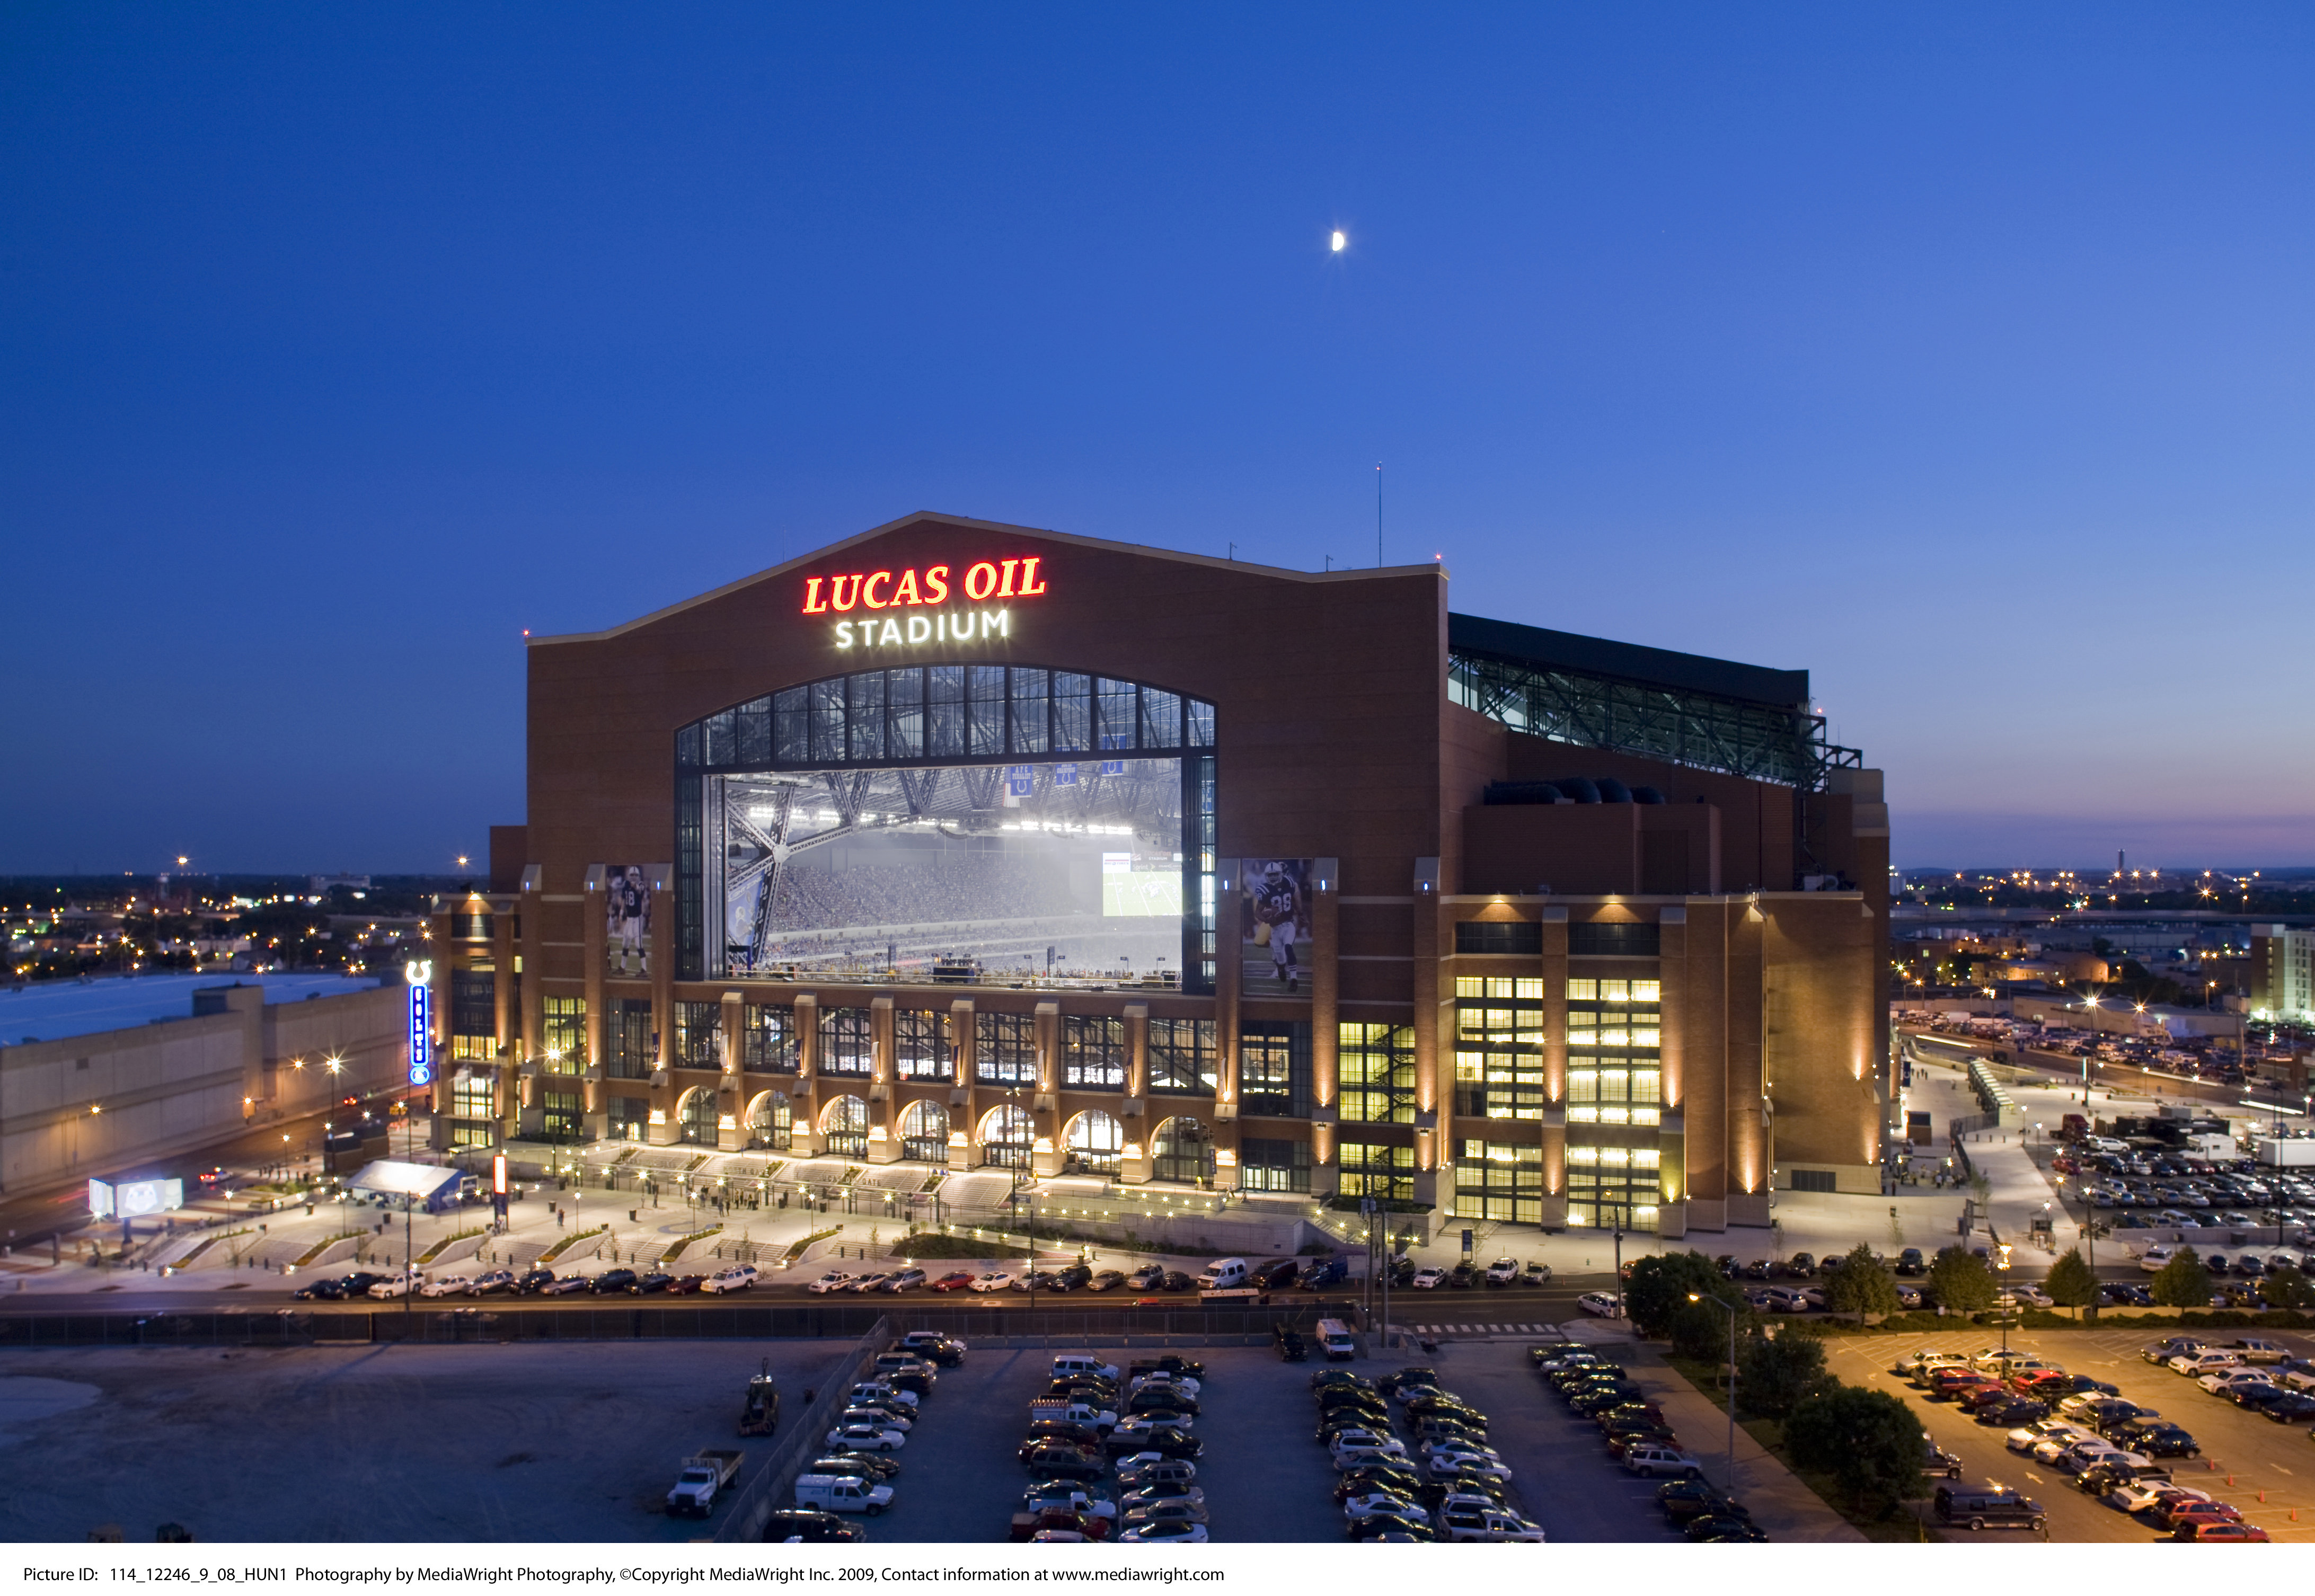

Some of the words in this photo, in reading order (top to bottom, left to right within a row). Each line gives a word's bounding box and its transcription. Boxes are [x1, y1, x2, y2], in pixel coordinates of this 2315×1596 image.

[802, 565, 949, 614] LUCAS
[964, 556, 1046, 600] OIL
[835, 609, 1009, 649] STADIUM
[625, 890, 635, 906] 18
[414, 988, 423, 1061] COLTS
